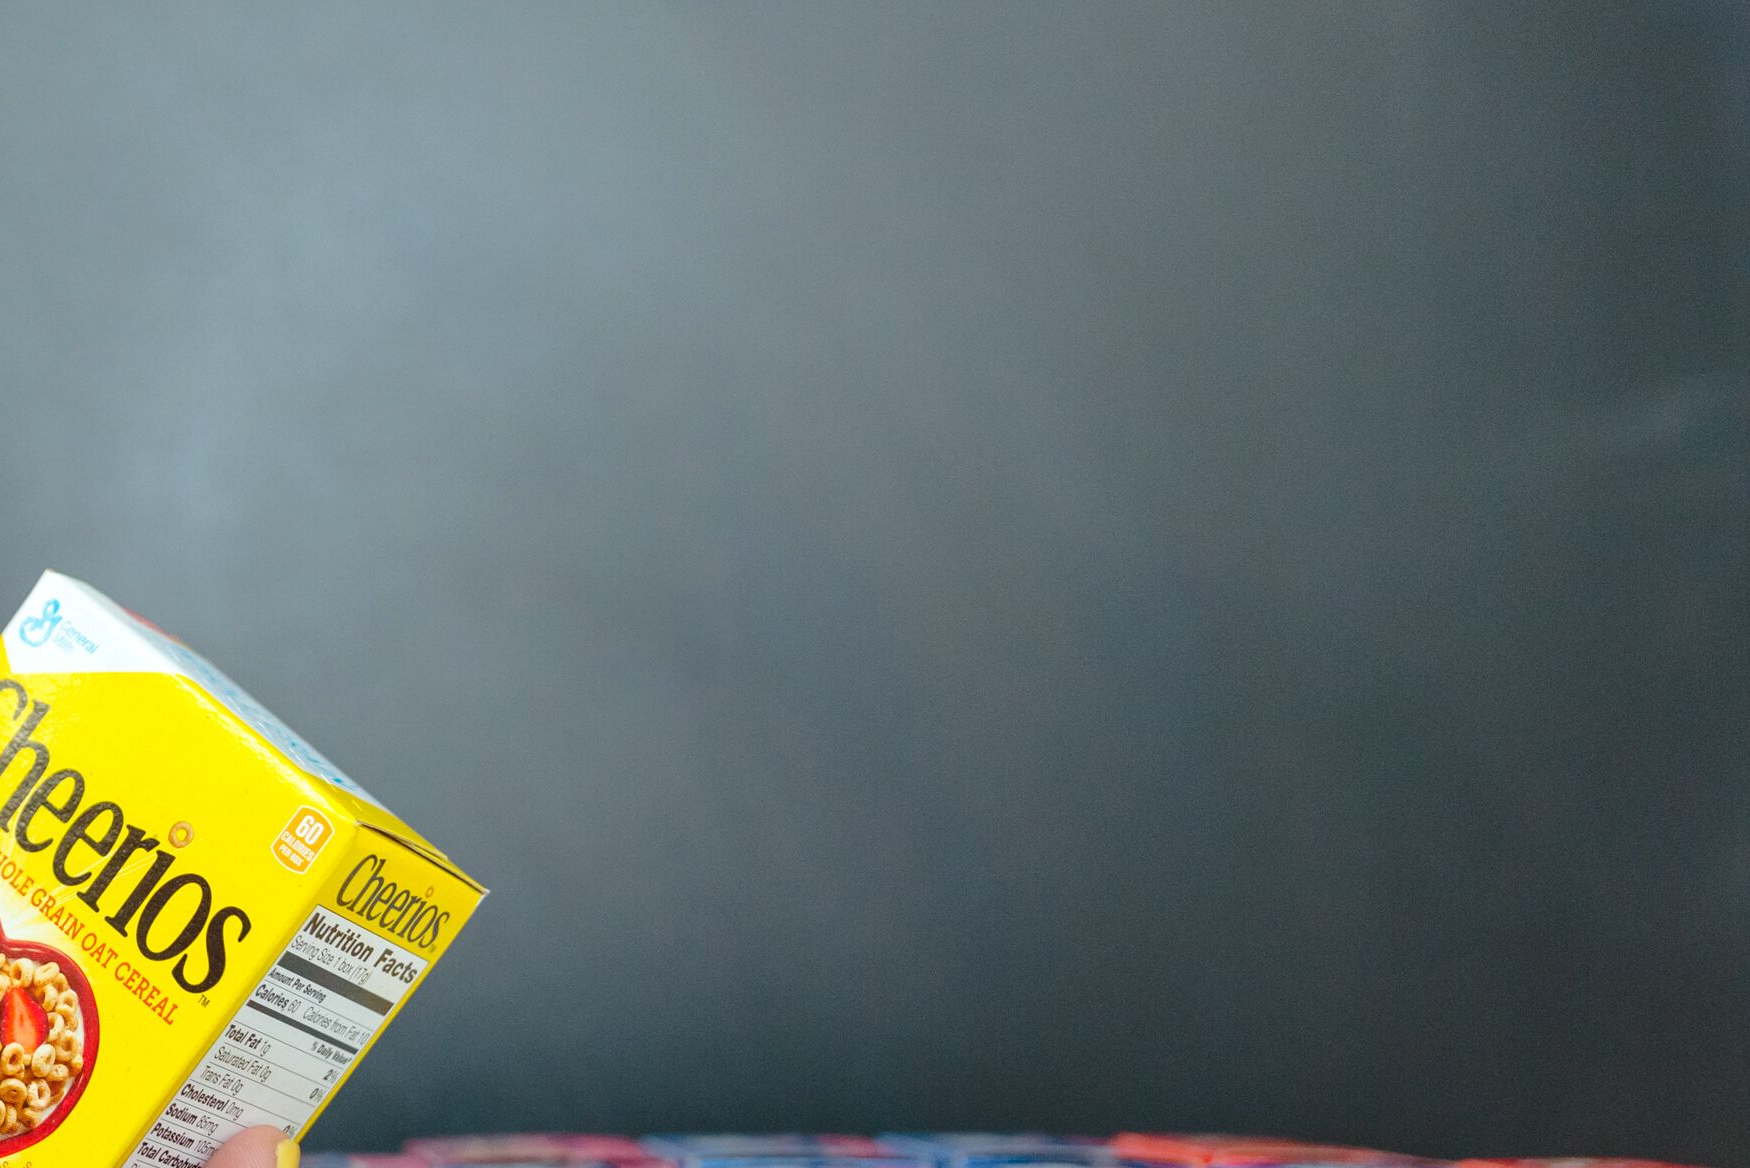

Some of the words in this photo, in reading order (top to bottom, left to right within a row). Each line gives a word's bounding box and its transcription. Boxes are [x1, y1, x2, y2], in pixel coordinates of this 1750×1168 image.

[281, 830, 315, 861] CALORIES
[295, 815, 324, 846] 60
[278, 844, 292, 858] PER
[336, 854, 451, 949] Cheerios
[31, 888, 84, 941] GRAIN
[81, 933, 120, 973] OAT
[113, 963, 178, 1025] CEREAL
[291, 934, 317, 960] Serving
[316, 947, 333, 966] Size
[337, 957, 354, 976] box
[350, 962, 372, 986] (17g)
[303, 912, 375, 963] Nutrition
[374, 948, 418, 984] Facts
[268, 967, 299, 989] Amount
[296, 978, 307, 992] Per
[303, 983, 327, 1003] Serving
[255, 984, 290, 1011] Calories
[287, 1000, 301, 1014] 60
[302, 1006, 333, 1032] Calories
[330, 1022, 349, 1042] from
[344, 1026, 361, 1043] Fat
[224, 1024, 245, 1043] Total
[243, 1032, 262, 1050] Fat
[258, 1040, 272, 1057] 1g
[317, 1044, 333, 1059] Daily
[200, 1065, 222, 1084] Trans
[219, 1073, 235, 1090] Fat
[231, 1078, 244, 1096] 0g
[214, 1046, 251, 1071] Saturated
[246, 1057, 262, 1075] Fat
[259, 1065, 272, 1083] 0g
[165, 1103, 198, 1125] Sodium
[180, 1083, 228, 1112] Cholesterol
[225, 1102, 244, 1121] 0mg
[136, 1142, 158, 1160] Total
[150, 1123, 195, 1149] Potassium
[193, 1138, 219, 1157] 105m
